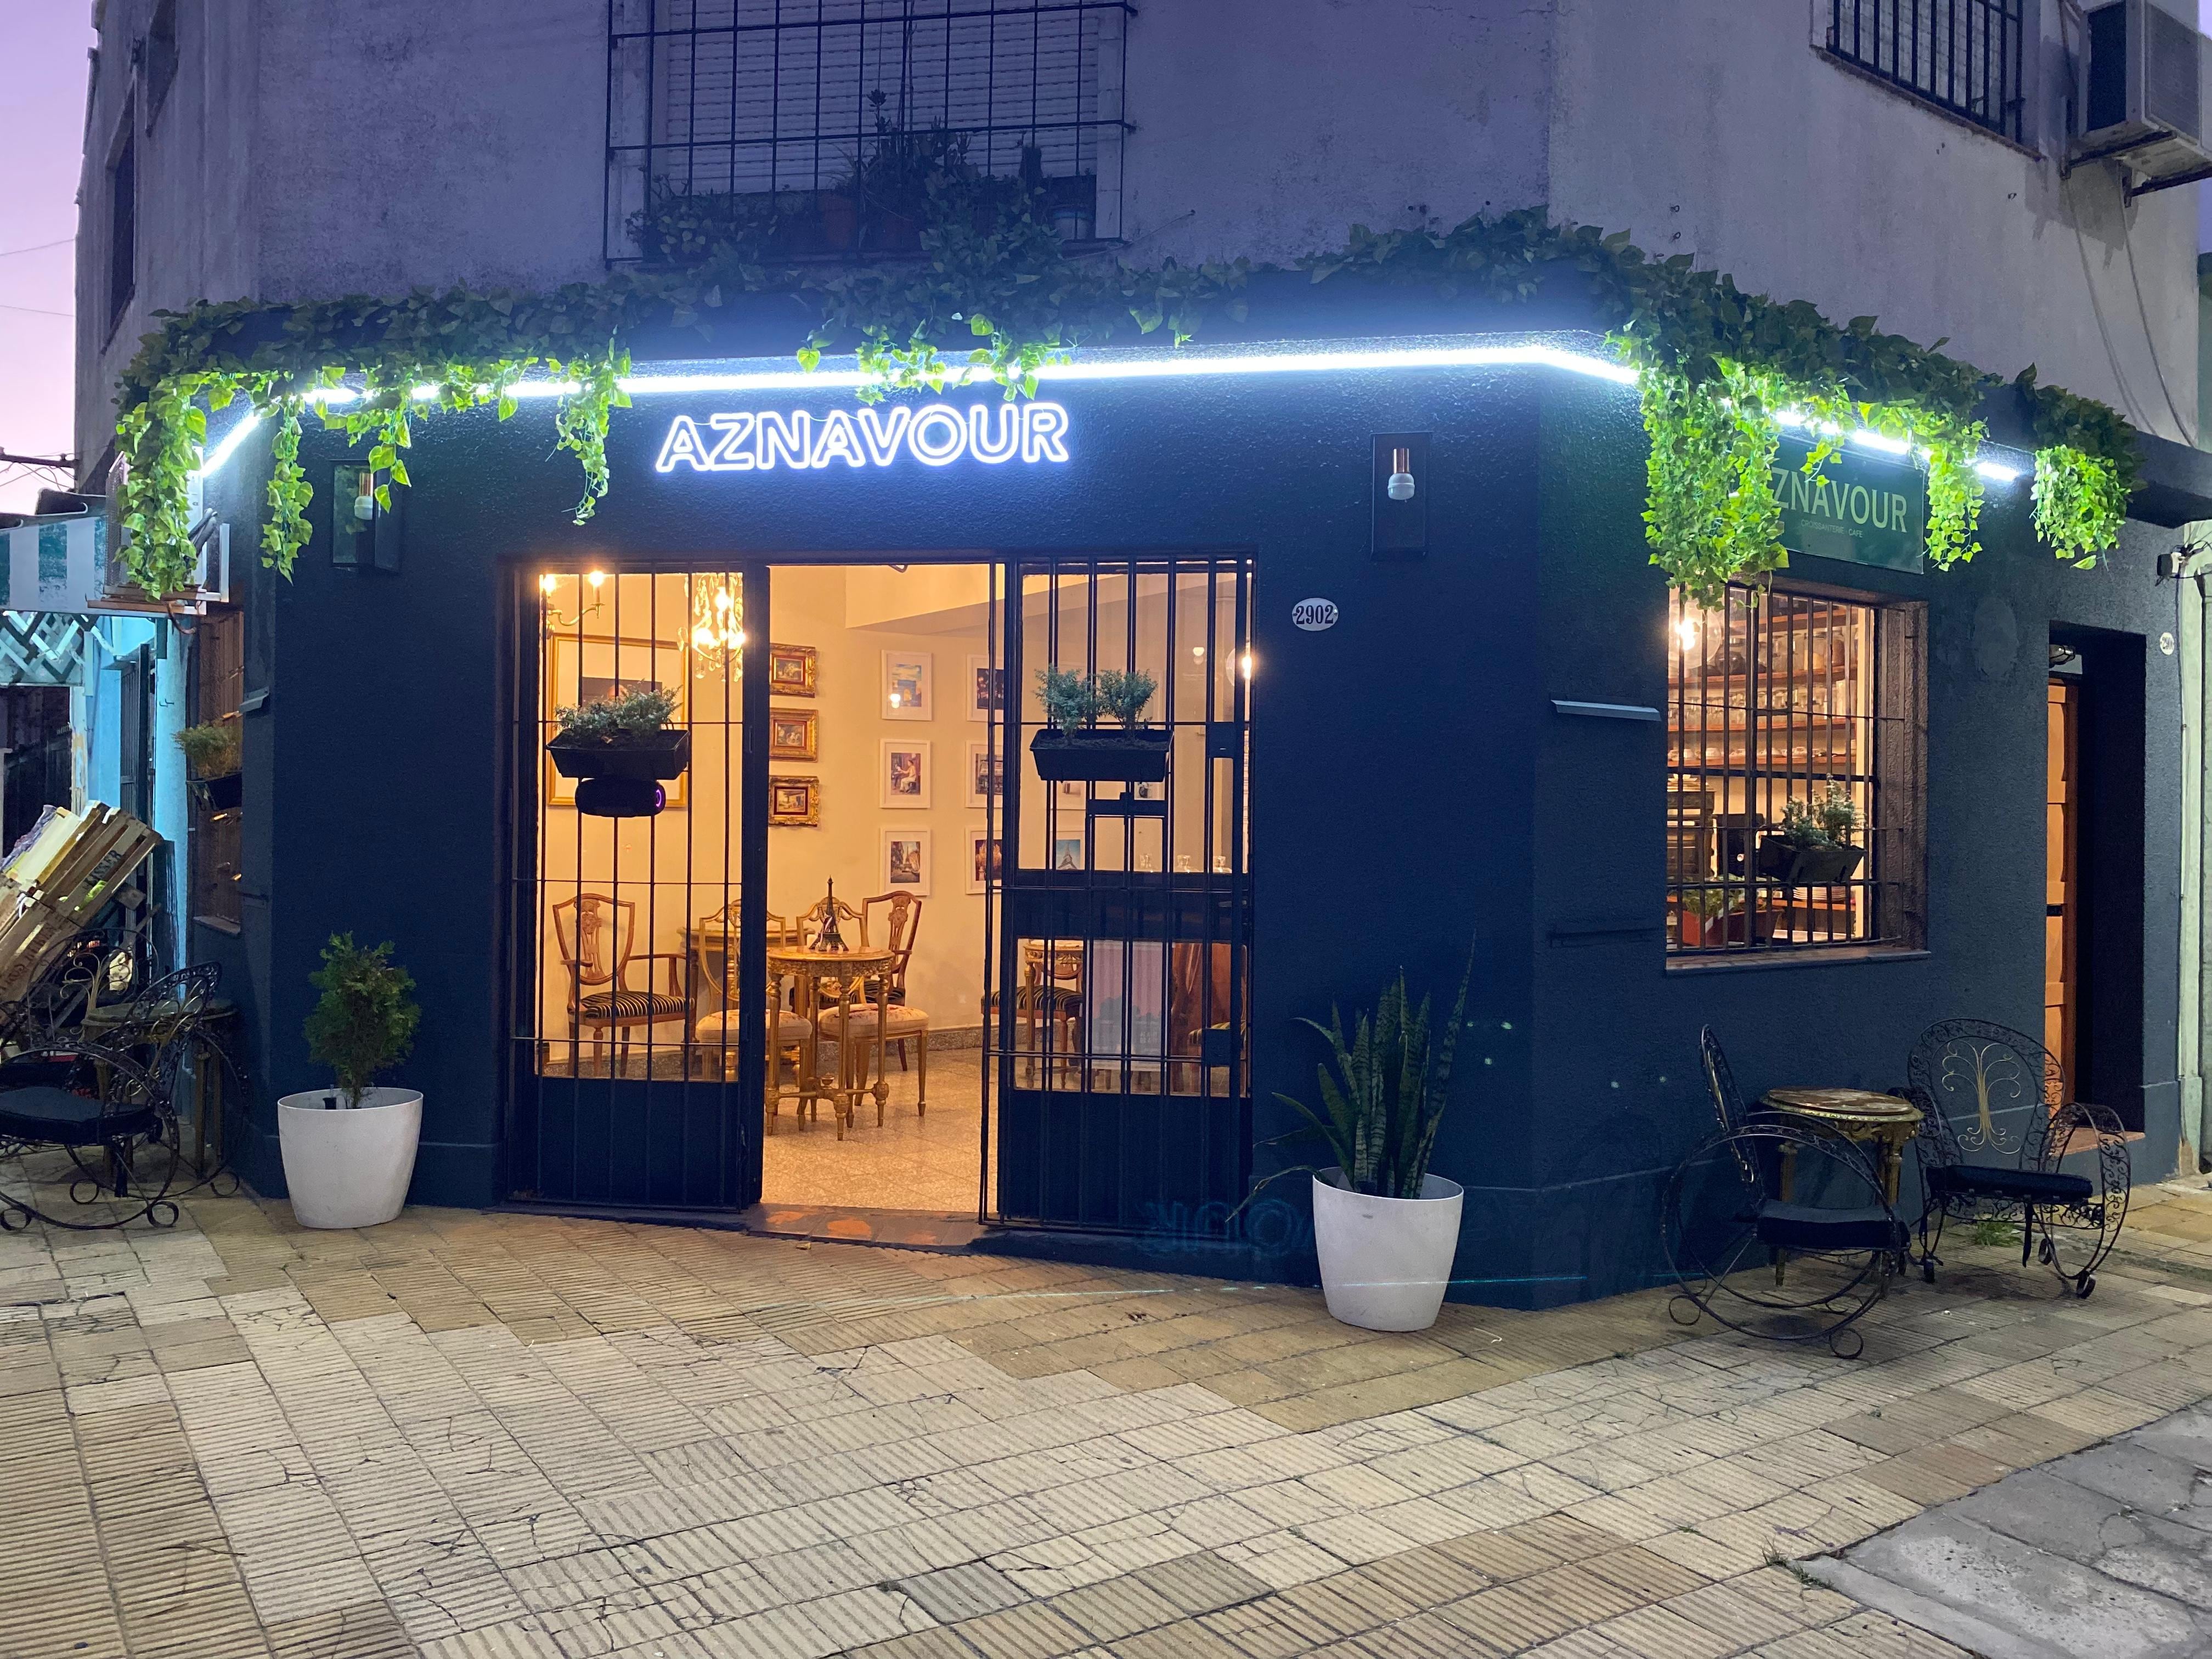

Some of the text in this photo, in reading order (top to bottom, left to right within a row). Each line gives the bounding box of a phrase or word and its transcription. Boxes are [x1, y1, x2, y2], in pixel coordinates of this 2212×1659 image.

[655, 403, 1069, 472] AZNAVOUR
[1770, 466, 1908, 533] ZNAVOUR
[1296, 605, 1334, 624] 2902
